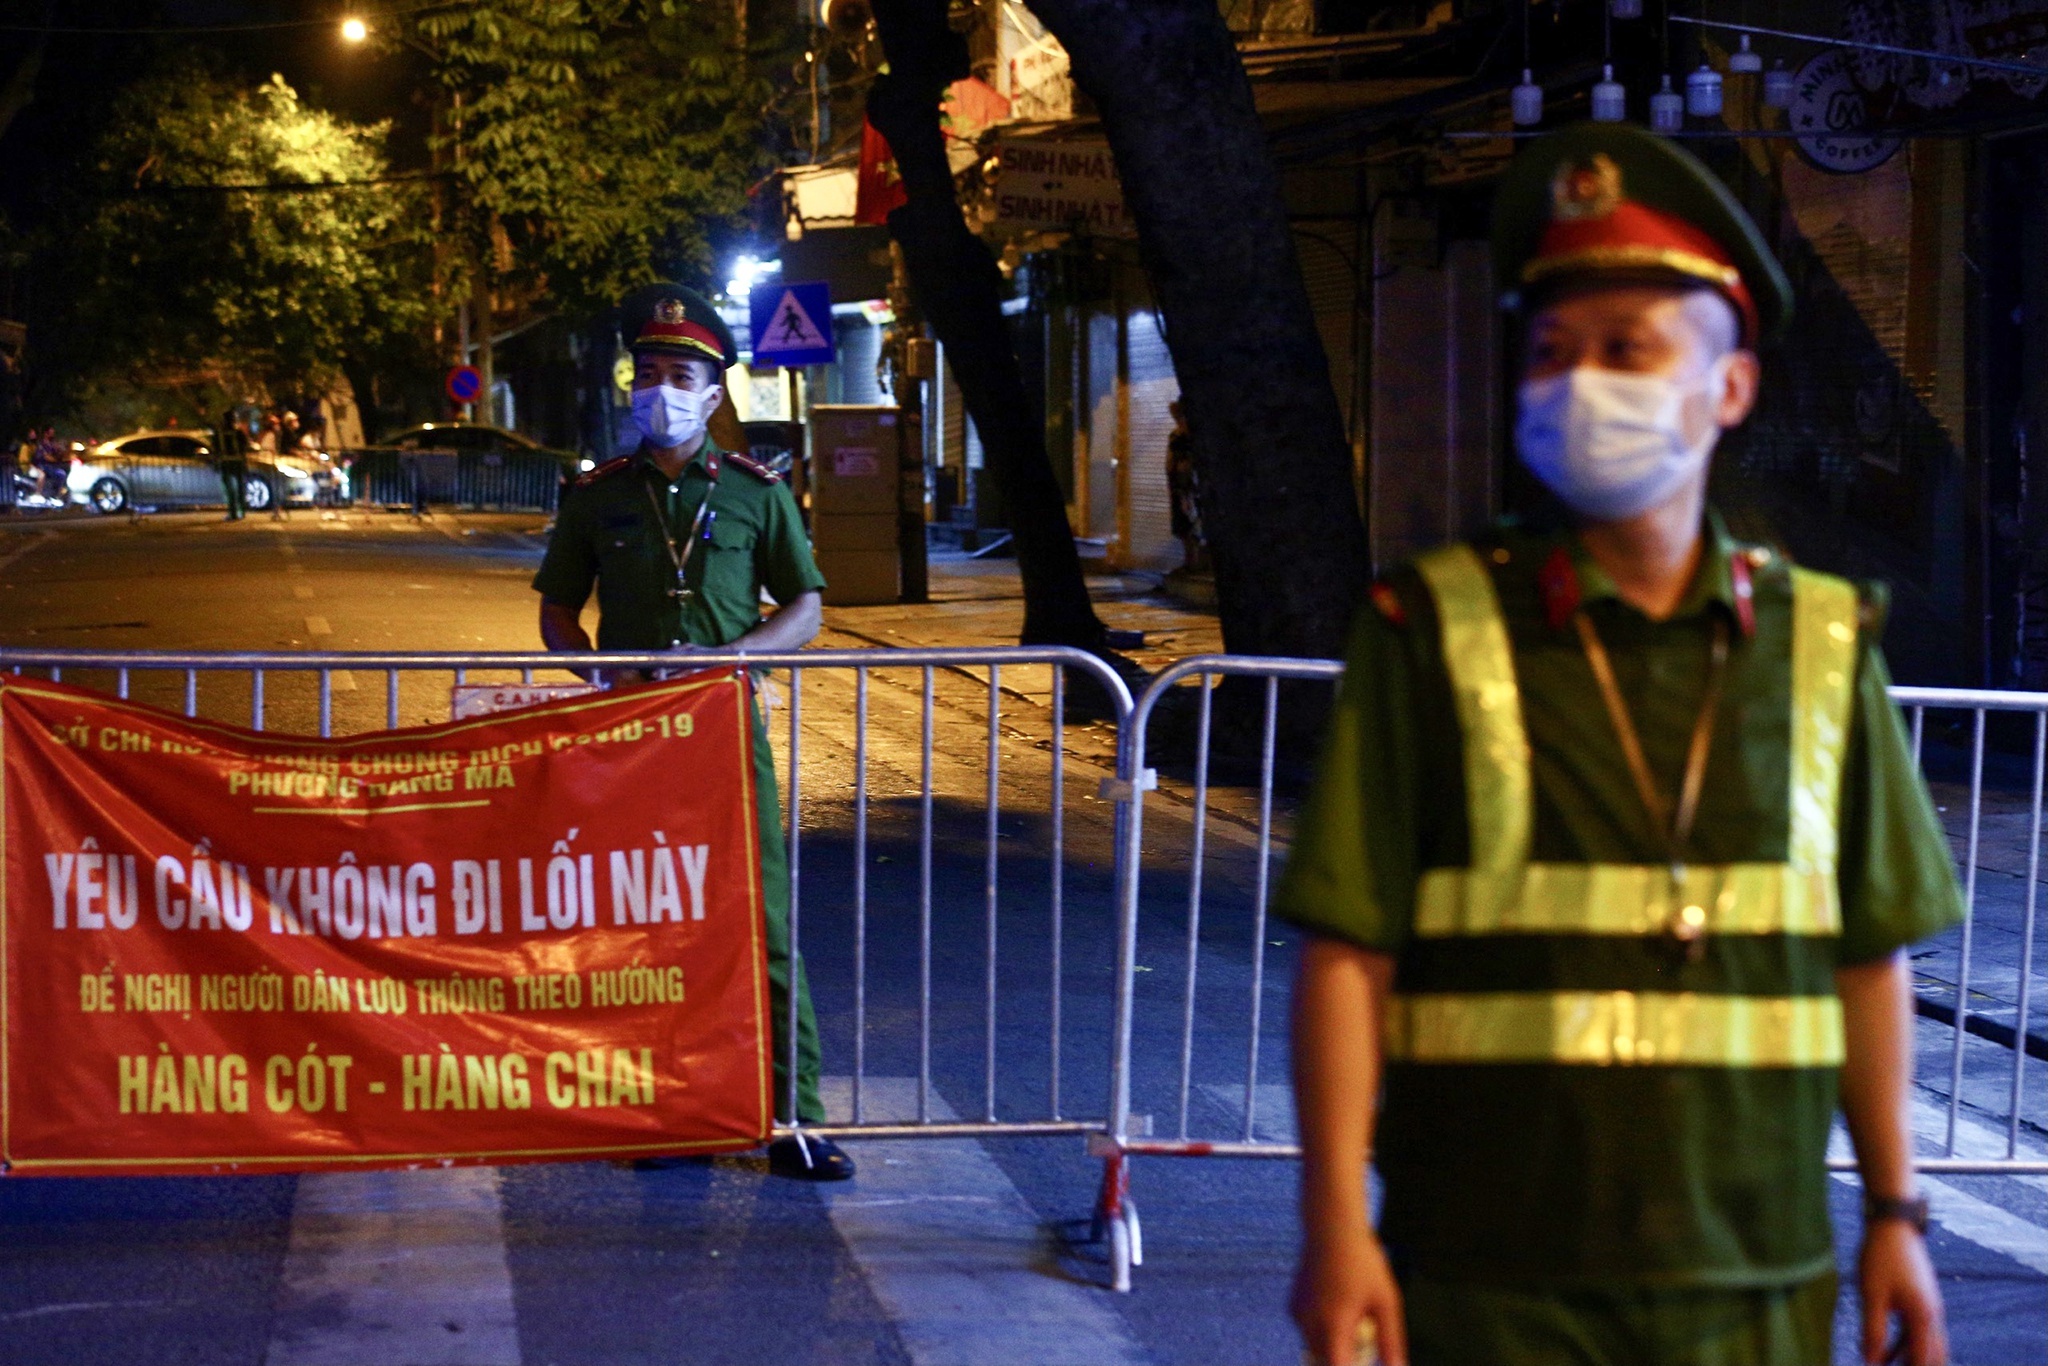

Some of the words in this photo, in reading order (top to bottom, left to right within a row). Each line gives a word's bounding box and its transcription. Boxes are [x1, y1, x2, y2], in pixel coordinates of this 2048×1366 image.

[44, 836, 138, 930] YÊU
[155, 836, 252, 931] CẦU
[264, 850, 437, 940] KHÔNG
[452, 859, 502, 935] ĐI
[518, 828, 595, 932] LỐI
[610, 830, 709, 926] NÀY
[124, 973, 192, 1021] NGHỊ
[200, 964, 284, 1012] NGƯỜI
[293, 968, 350, 1013] DÂN
[414, 972, 505, 1014] THÔNG
[513, 973, 582, 1010] THEO
[590, 957, 685, 1007] HƯỚNG
[118, 1042, 249, 1114] HÀNG
[265, 1042, 353, 1113] CÓT
[368, 1081, 386, 1094] -
[402, 1043, 532, 1111] HÀNG
[545, 1047, 656, 1109] CHAI
